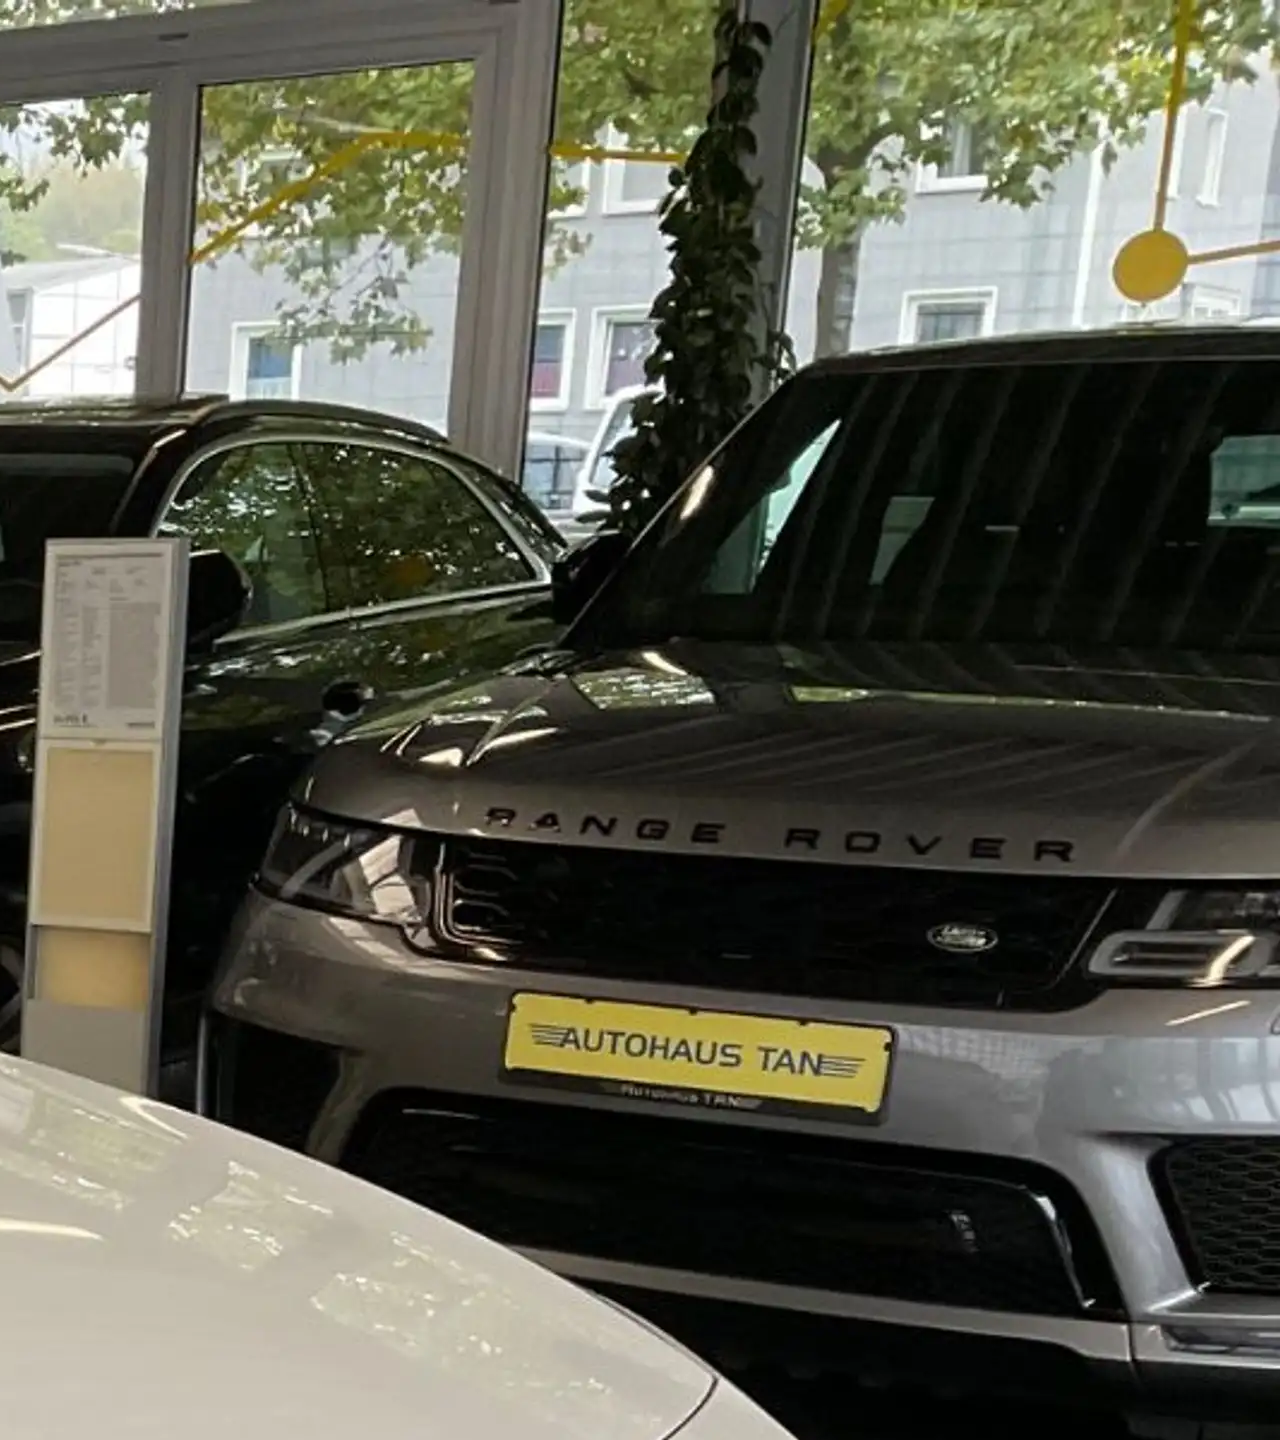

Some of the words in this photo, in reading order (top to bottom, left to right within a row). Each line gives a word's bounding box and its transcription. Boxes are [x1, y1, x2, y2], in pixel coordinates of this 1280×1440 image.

[484, 807, 726, 845] RANGE
[783, 827, 1075, 863] ROVER
[560, 1026, 744, 1068] AUTOHAUS
[758, 1046, 824, 1077] TAN
